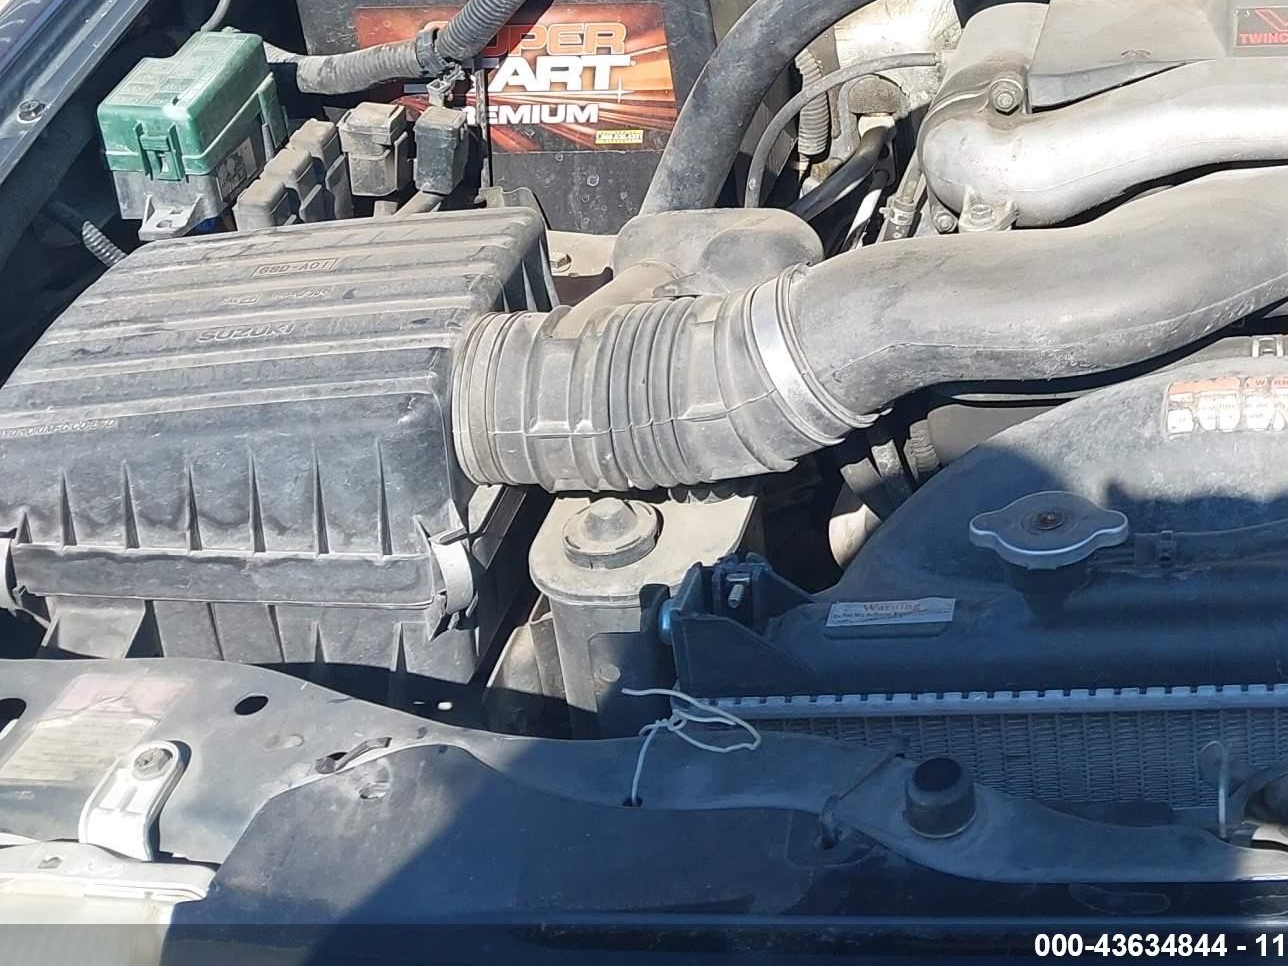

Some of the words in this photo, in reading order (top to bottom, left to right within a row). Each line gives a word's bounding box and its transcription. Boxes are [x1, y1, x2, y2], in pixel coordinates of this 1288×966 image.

[463, 102, 599, 125] REMIUM
[196, 321, 297, 343] SUZUKI
[863, 603, 920, 614] Warning
